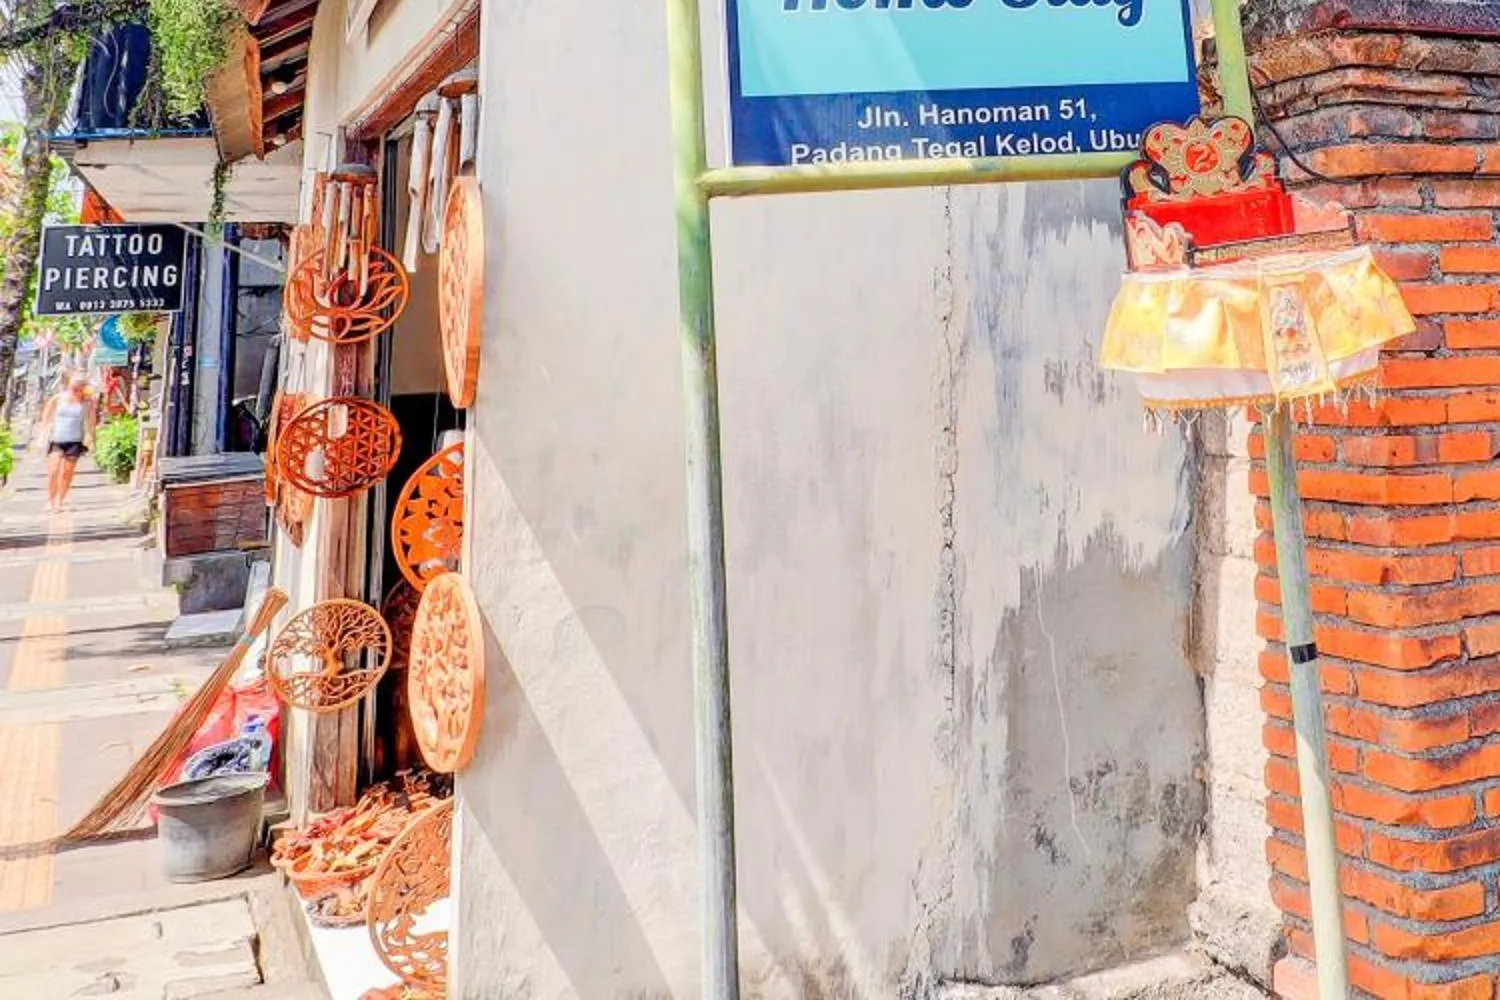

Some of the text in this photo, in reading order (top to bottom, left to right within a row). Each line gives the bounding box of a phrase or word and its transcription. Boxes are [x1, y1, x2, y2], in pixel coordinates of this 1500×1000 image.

[857, 99, 1097, 129] Jln. Hanoman 51,
[790, 128, 1142, 167] Padang Tegal Kelod, Ubu
[65, 233, 164, 257] TATTOO
[44, 265, 178, 291] PIERCING
